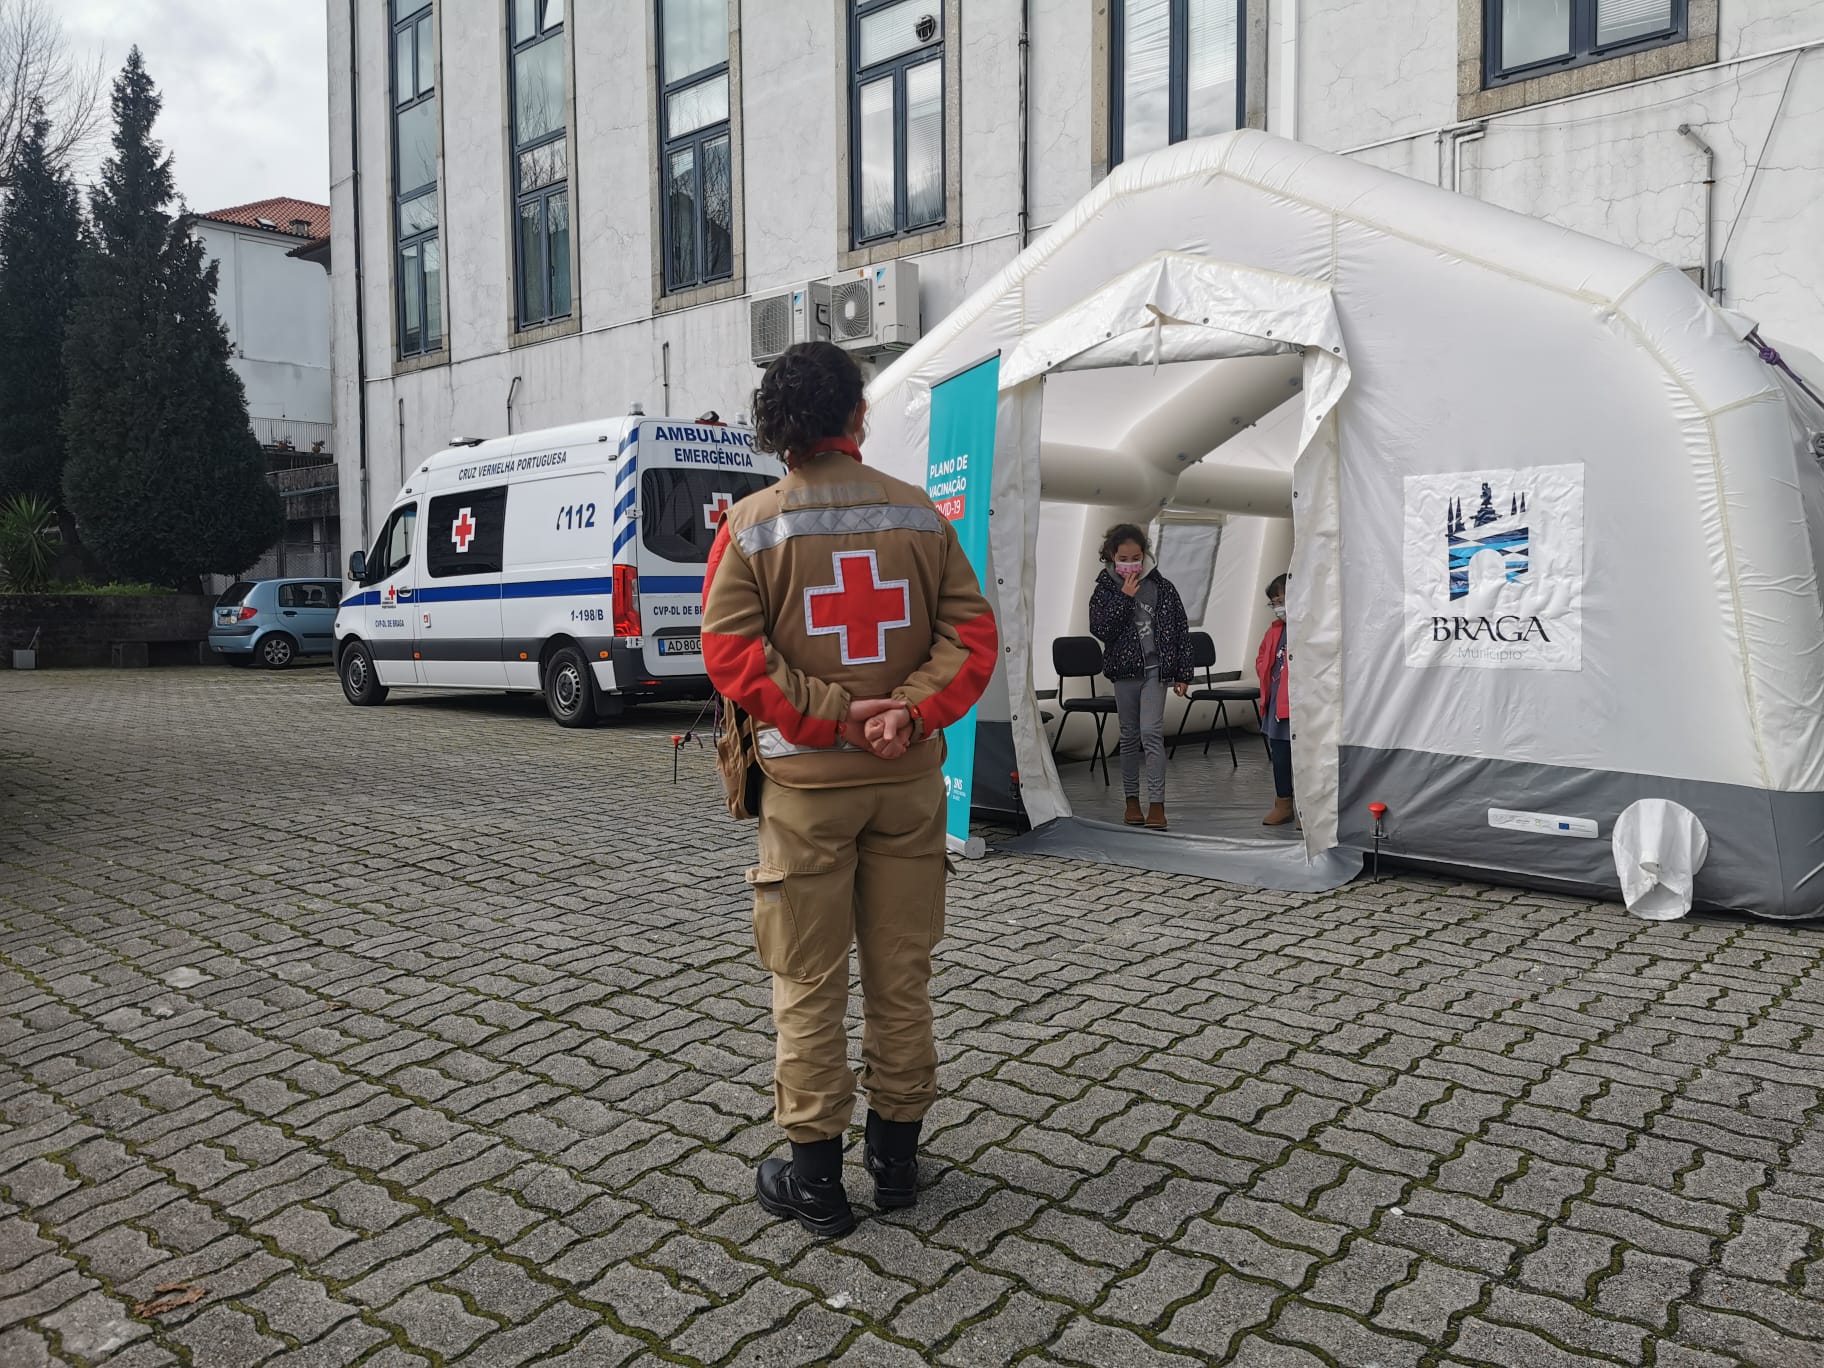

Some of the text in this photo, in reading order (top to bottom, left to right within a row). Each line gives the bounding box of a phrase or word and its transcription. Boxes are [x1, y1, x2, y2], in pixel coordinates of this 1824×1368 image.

[655, 426, 754, 447] AMBULÂNC
[458, 451, 567, 480] CRUZ VERMELHA PORTUGUESA
[674, 448, 753, 467] EMERGÊNCIA
[929, 454, 968, 479] PLANO DE
[929, 475, 967, 498] VACINAÇÃO
[565, 502, 596, 530] 112
[653, 605, 680, 616] CVP-DL
[682, 605, 693, 615] DE
[1431, 615, 1552, 643] BRAGA
